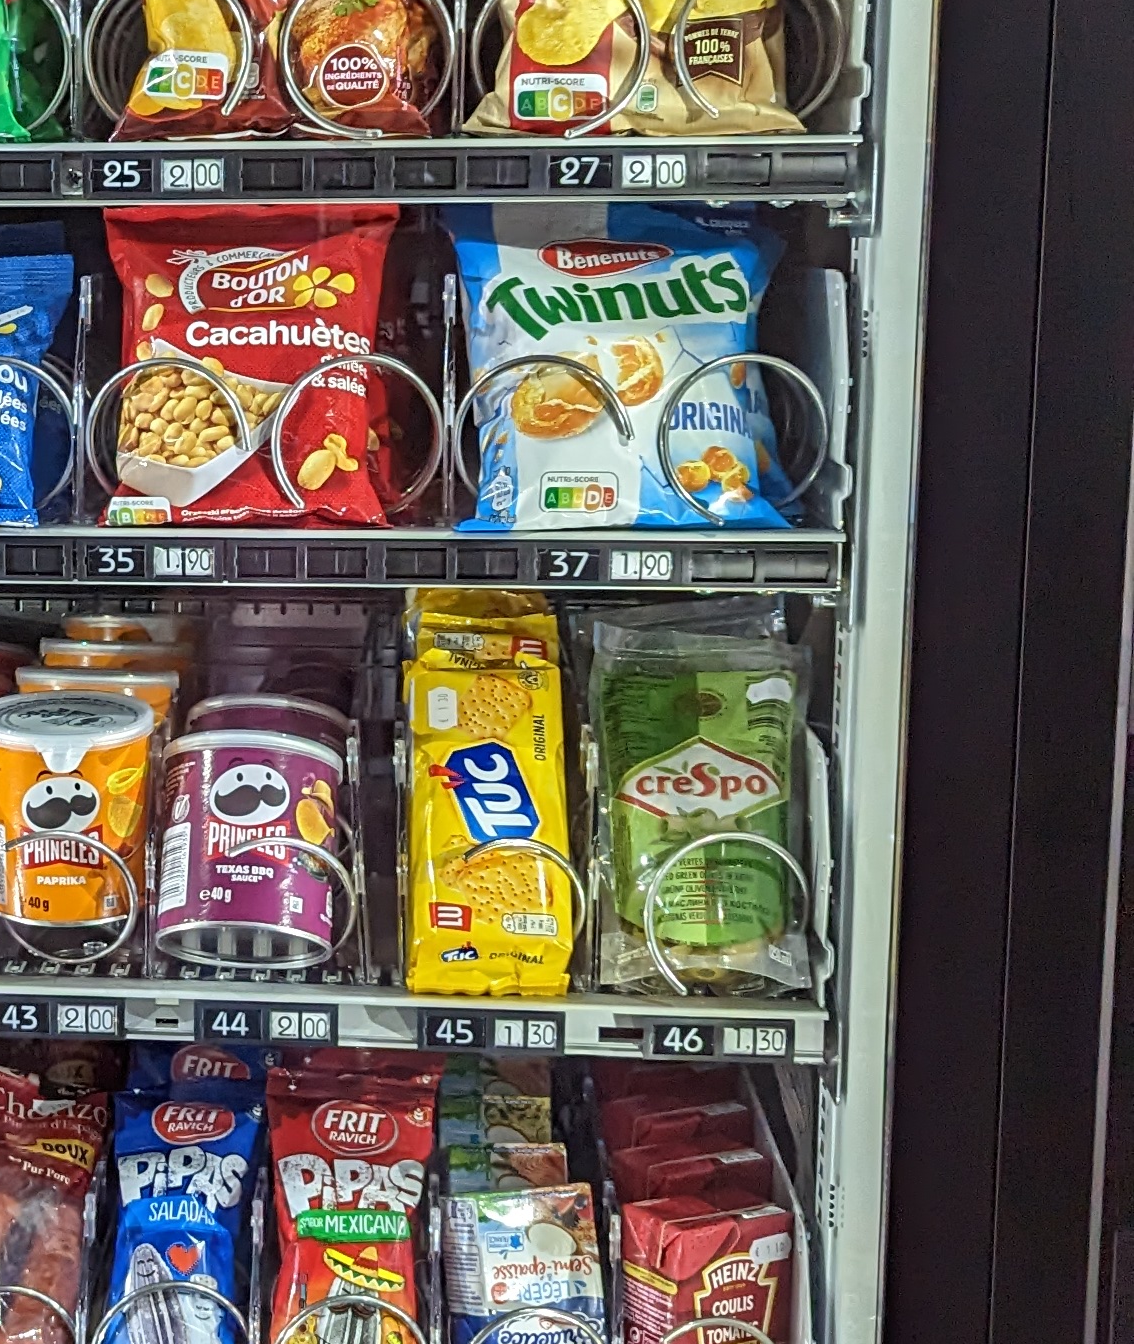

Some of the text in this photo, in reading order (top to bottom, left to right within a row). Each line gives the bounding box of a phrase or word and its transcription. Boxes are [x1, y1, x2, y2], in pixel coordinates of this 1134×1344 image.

[694, 38, 731, 55] 100%
[330, 57, 378, 72] 100%
[335, 77, 381, 92] QUALITÉ
[521, 76, 586, 87] NUTRI-SCORE
[102, 162, 141, 188] 25
[560, 158, 600, 184] 27
[556, 248, 659, 271] Benenuts
[211, 255, 309, 292] BOUTON
[230, 286, 285, 309] d'OR
[486, 258, 748, 342] Twinuts
[185, 317, 372, 357] Cacahuètes
[98, 548, 134, 572] 35
[549, 551, 590, 577] 37
[535, 713, 546, 762] ORIGINAL
[36, 875, 86, 886] PAPRIKA
[215, 864, 249, 875] TEXAS
[2, 1005, 38, 1029] 43
[211, 1013, 249, 1036] 44
[435, 1018, 474, 1043] 45
[663, 1026, 703, 1052] 46
[163, 1105, 222, 1124] FRIT
[323, 1110, 387, 1134] FRIT
[167, 1121, 214, 1134] RAVICH
[329, 1131, 378, 1145] RAVICH
[41, 1142, 89, 1165] DOUX
[149, 1199, 216, 1226] SALADAS
[324, 1215, 408, 1236] MEXICANO
[710, 1261, 757, 1289] HEINZ
[711, 1296, 755, 1314] COULIS
